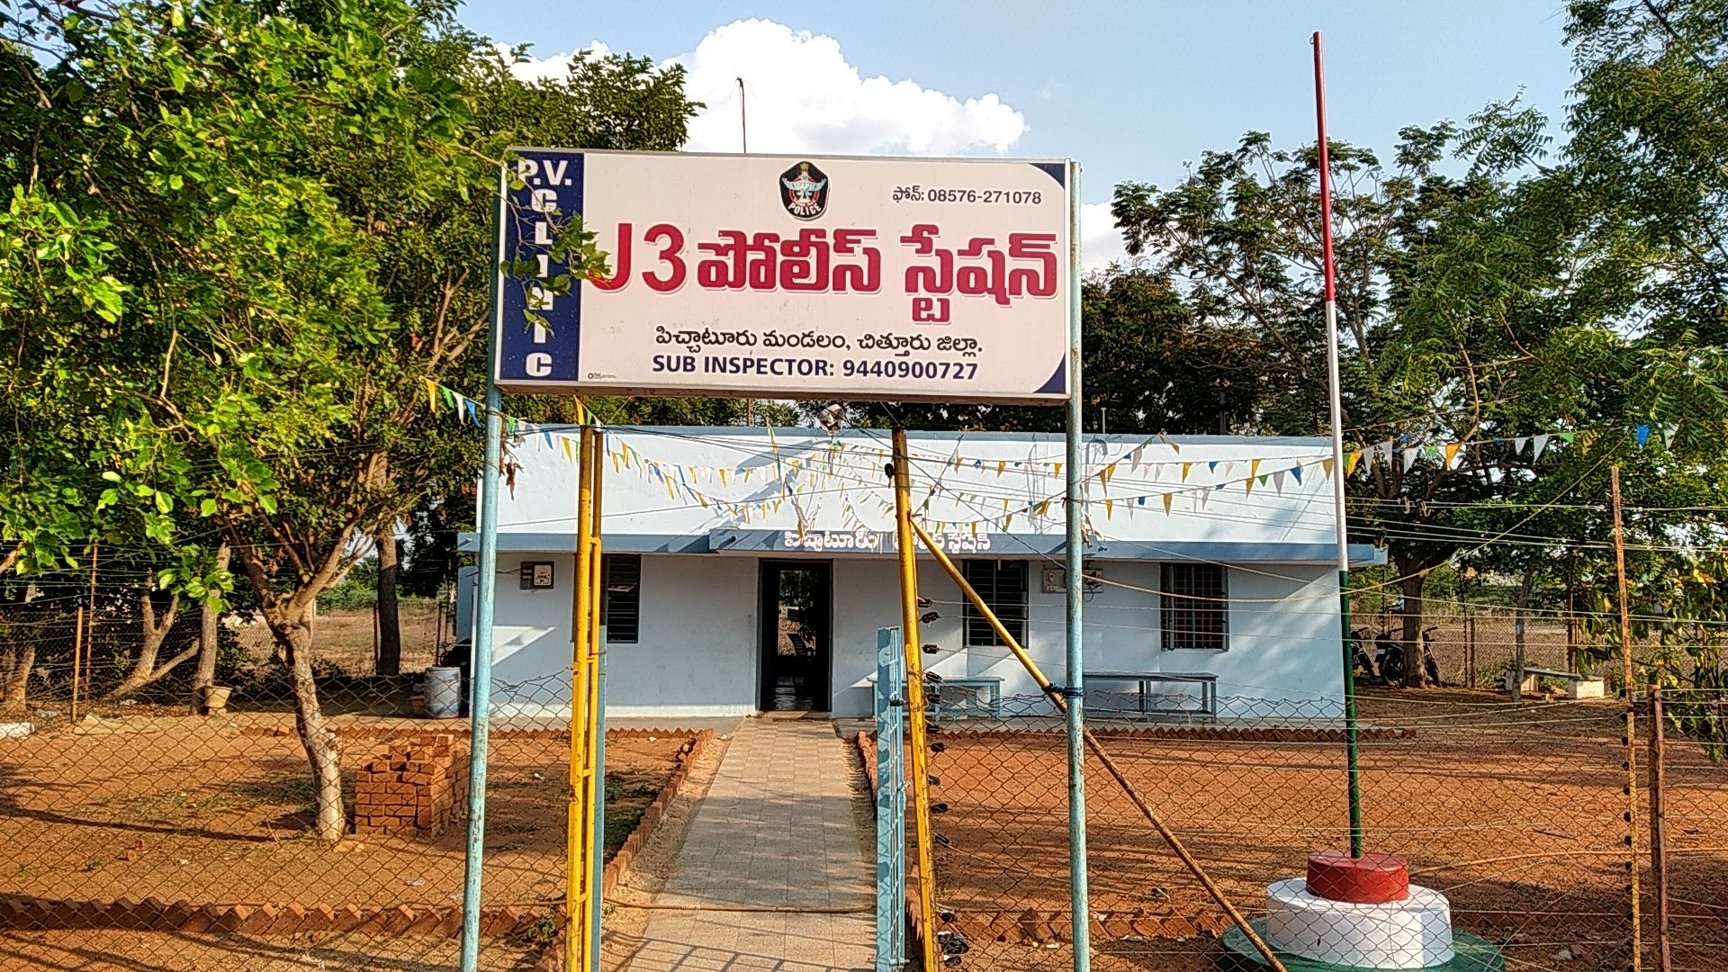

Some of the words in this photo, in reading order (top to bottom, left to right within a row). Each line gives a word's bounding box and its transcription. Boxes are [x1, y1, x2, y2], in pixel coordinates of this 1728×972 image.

[517, 160, 572, 186] P.V.
[788, 202, 821, 216] POLICE
[928, 189, 1042, 205] 08576-271078
[698, 228, 881, 292] పోలీస్
[900, 224, 1057, 323] స్టేషన్
[655, 325, 757, 353] పిచ్చాటూరు
[762, 329, 851, 350] మండలం,
[857, 332, 931, 357] చిత్తూరు
[936, 335, 983, 357] జిల్లా.
[652, 354, 697, 373] SUB
[703, 356, 835, 377] INSPECTOR:
[842, 360, 978, 380] 9440900727
